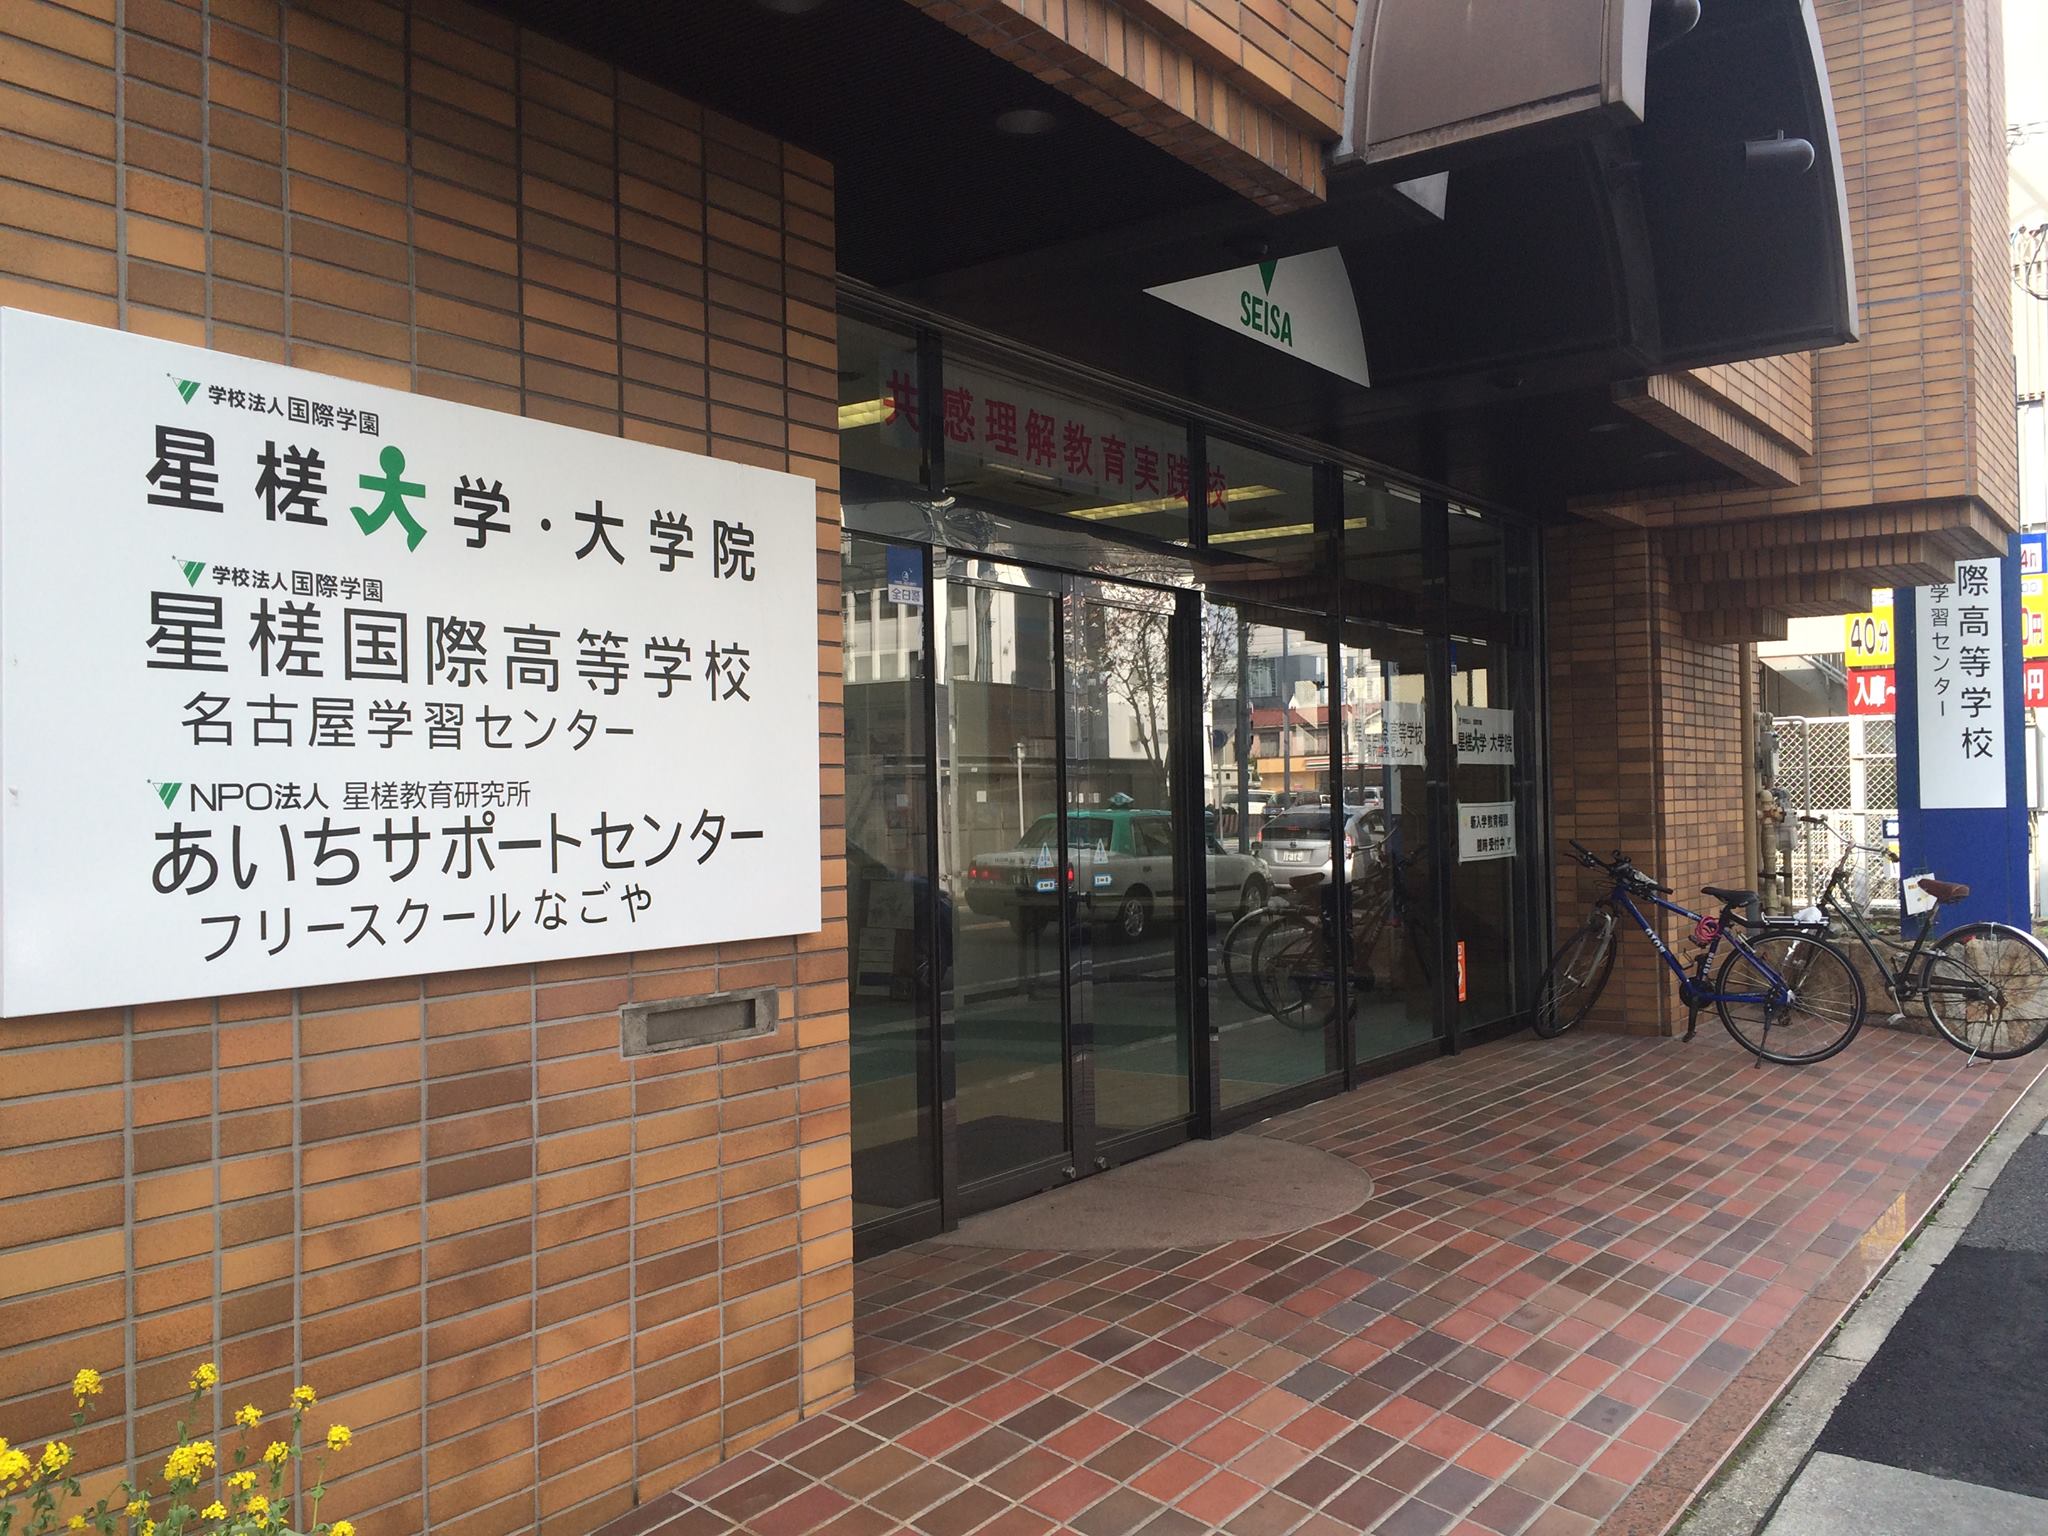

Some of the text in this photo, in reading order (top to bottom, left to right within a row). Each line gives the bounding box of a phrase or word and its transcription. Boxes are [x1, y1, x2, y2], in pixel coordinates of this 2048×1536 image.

[1240, 290, 1293, 347] SEISA
[208, 384, 380, 437] 学校法人国際学園
[211, 566, 384, 602] 学校法人国際学園
[145, 590, 751, 702] 星槎国際高等学校
[1930, 584, 1951, 716] 学習センター
[1957, 564, 1993, 759] 際高等学校
[2024, 668, 2044, 700] 円
[181, 690, 634, 751] 名古屋学習センター
[190, 780, 531, 812] NPO法人 星槎教育研究所
[152, 808, 764, 896] あいちサポートセンター
[201, 881, 652, 962] フリースクールなごや
